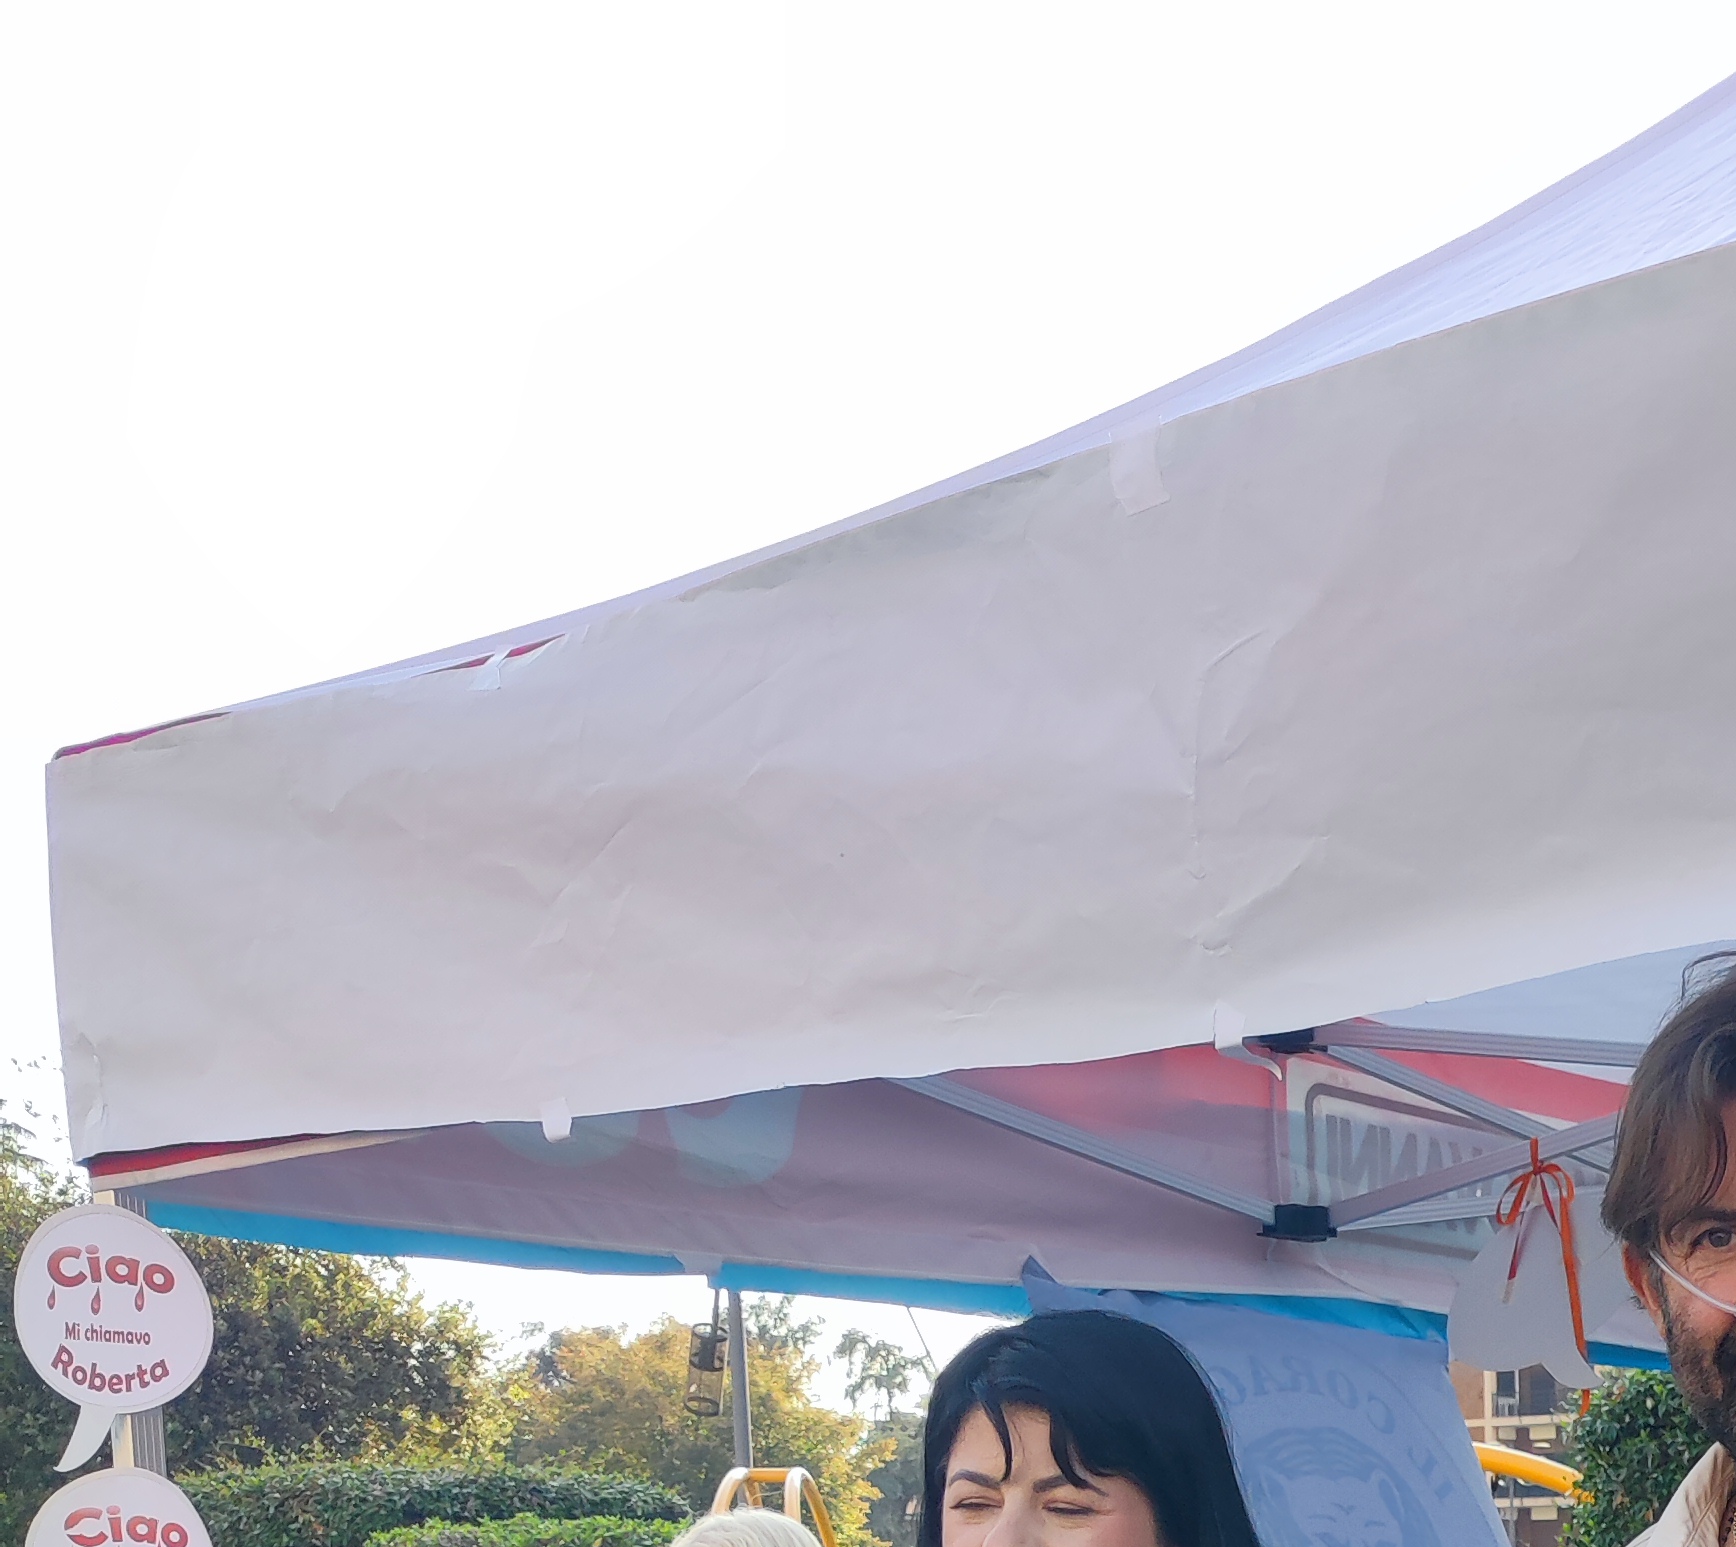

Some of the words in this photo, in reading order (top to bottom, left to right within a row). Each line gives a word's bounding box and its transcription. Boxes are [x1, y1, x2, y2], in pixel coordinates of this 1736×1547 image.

[46, 1244, 176, 1294] Ciao
[65, 1321, 82, 1340] Mi
[84, 1323, 151, 1345] chiamavo
[51, 1343, 170, 1394] Roberta
